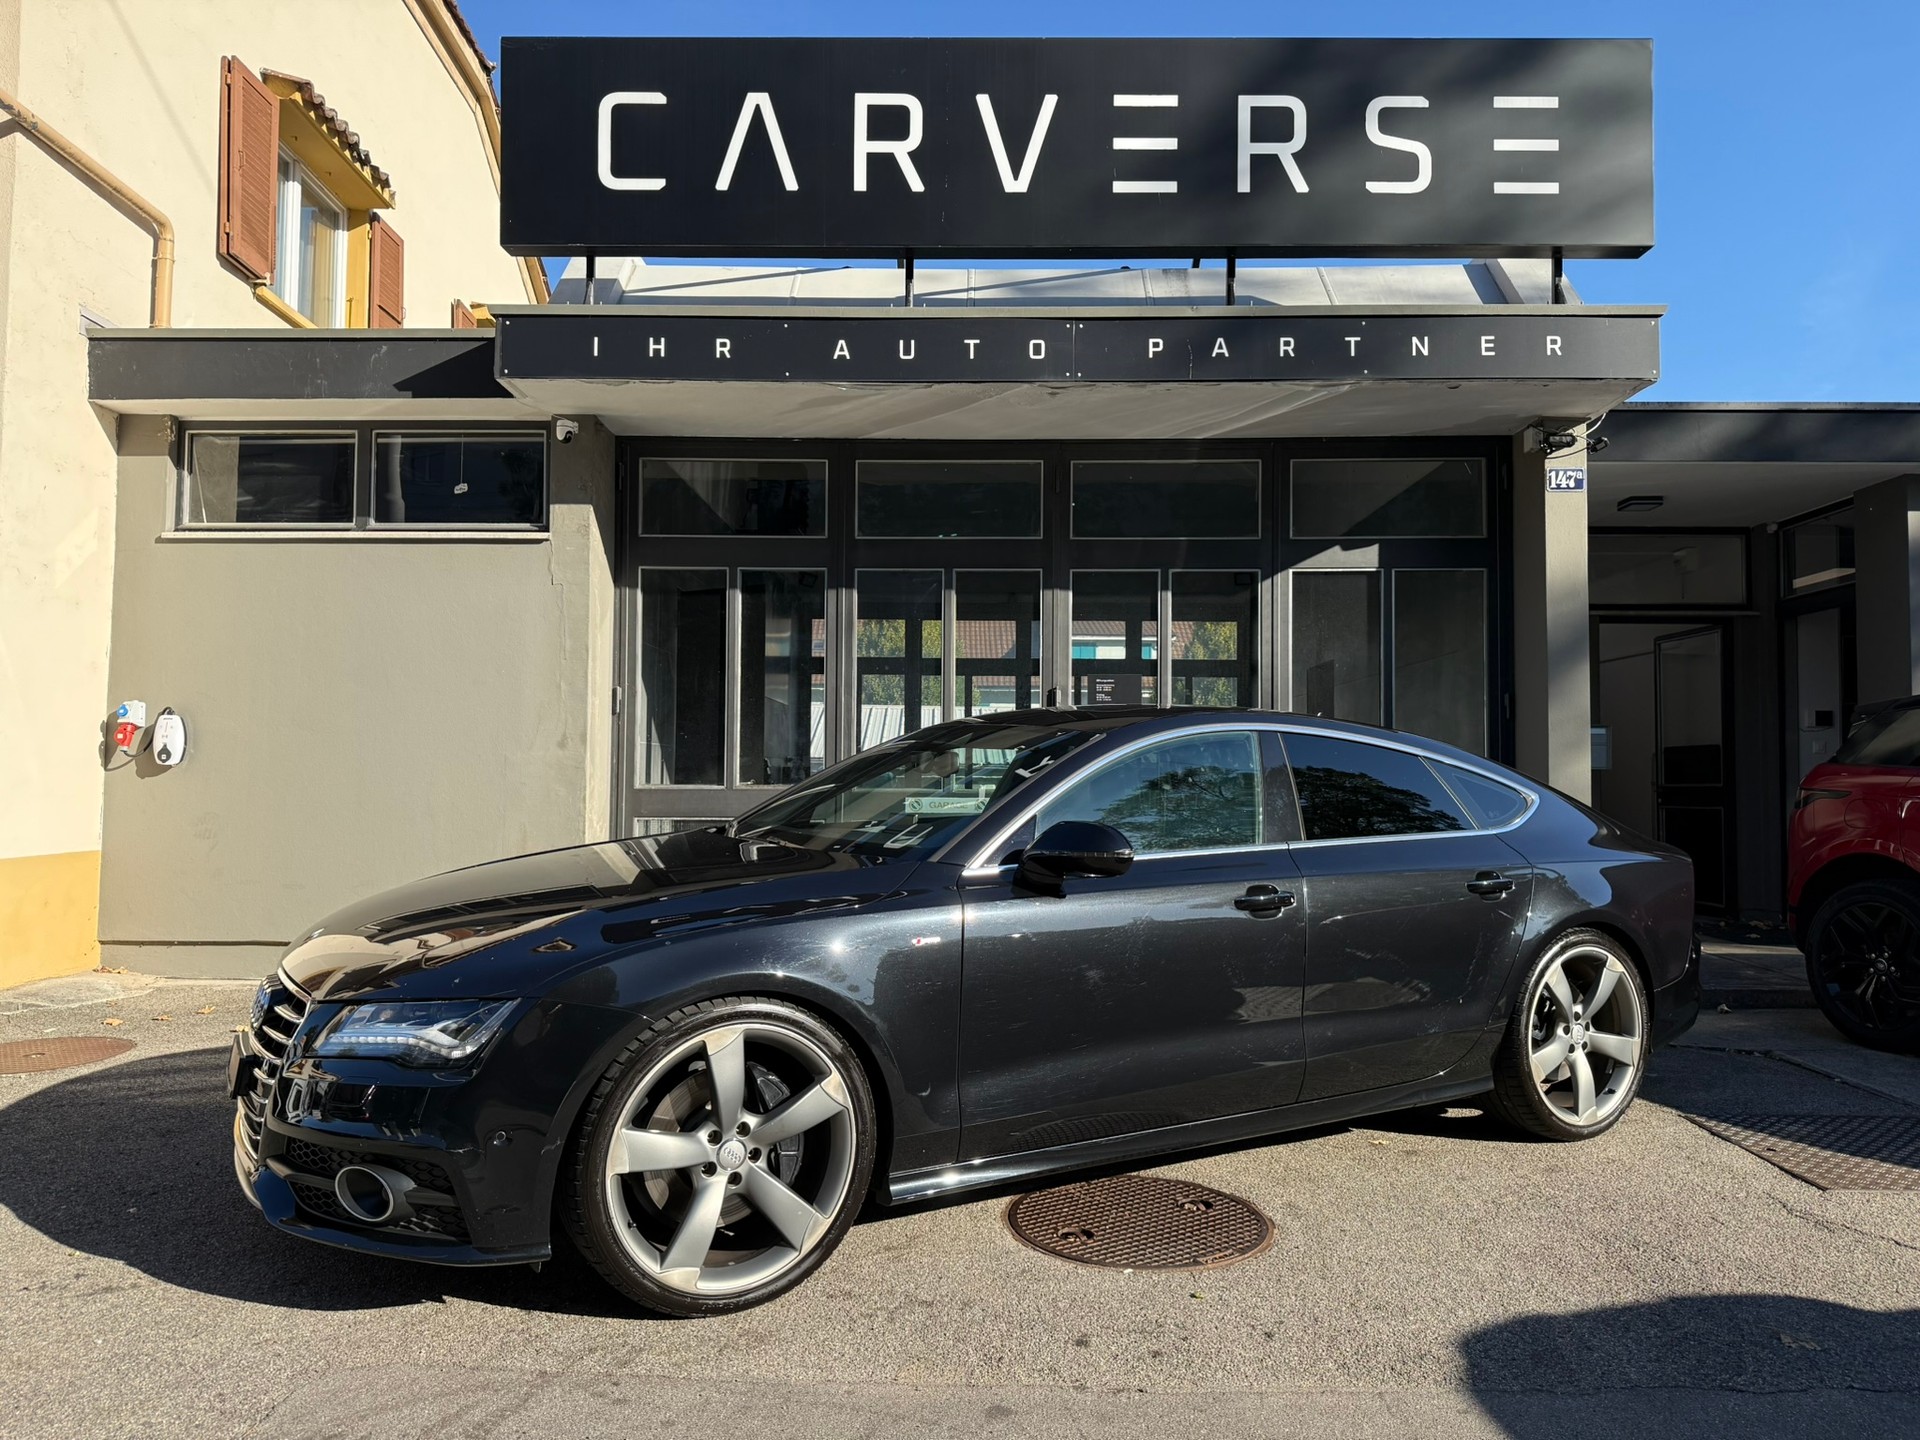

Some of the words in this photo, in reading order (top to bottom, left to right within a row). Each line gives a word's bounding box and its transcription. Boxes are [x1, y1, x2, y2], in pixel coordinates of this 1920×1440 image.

[597, 92, 1560, 195] CARVERSE
[593, 336, 731, 358] IHR
[833, 339, 1046, 360] AUTO
[1148, 335, 1563, 359] PARTNER
